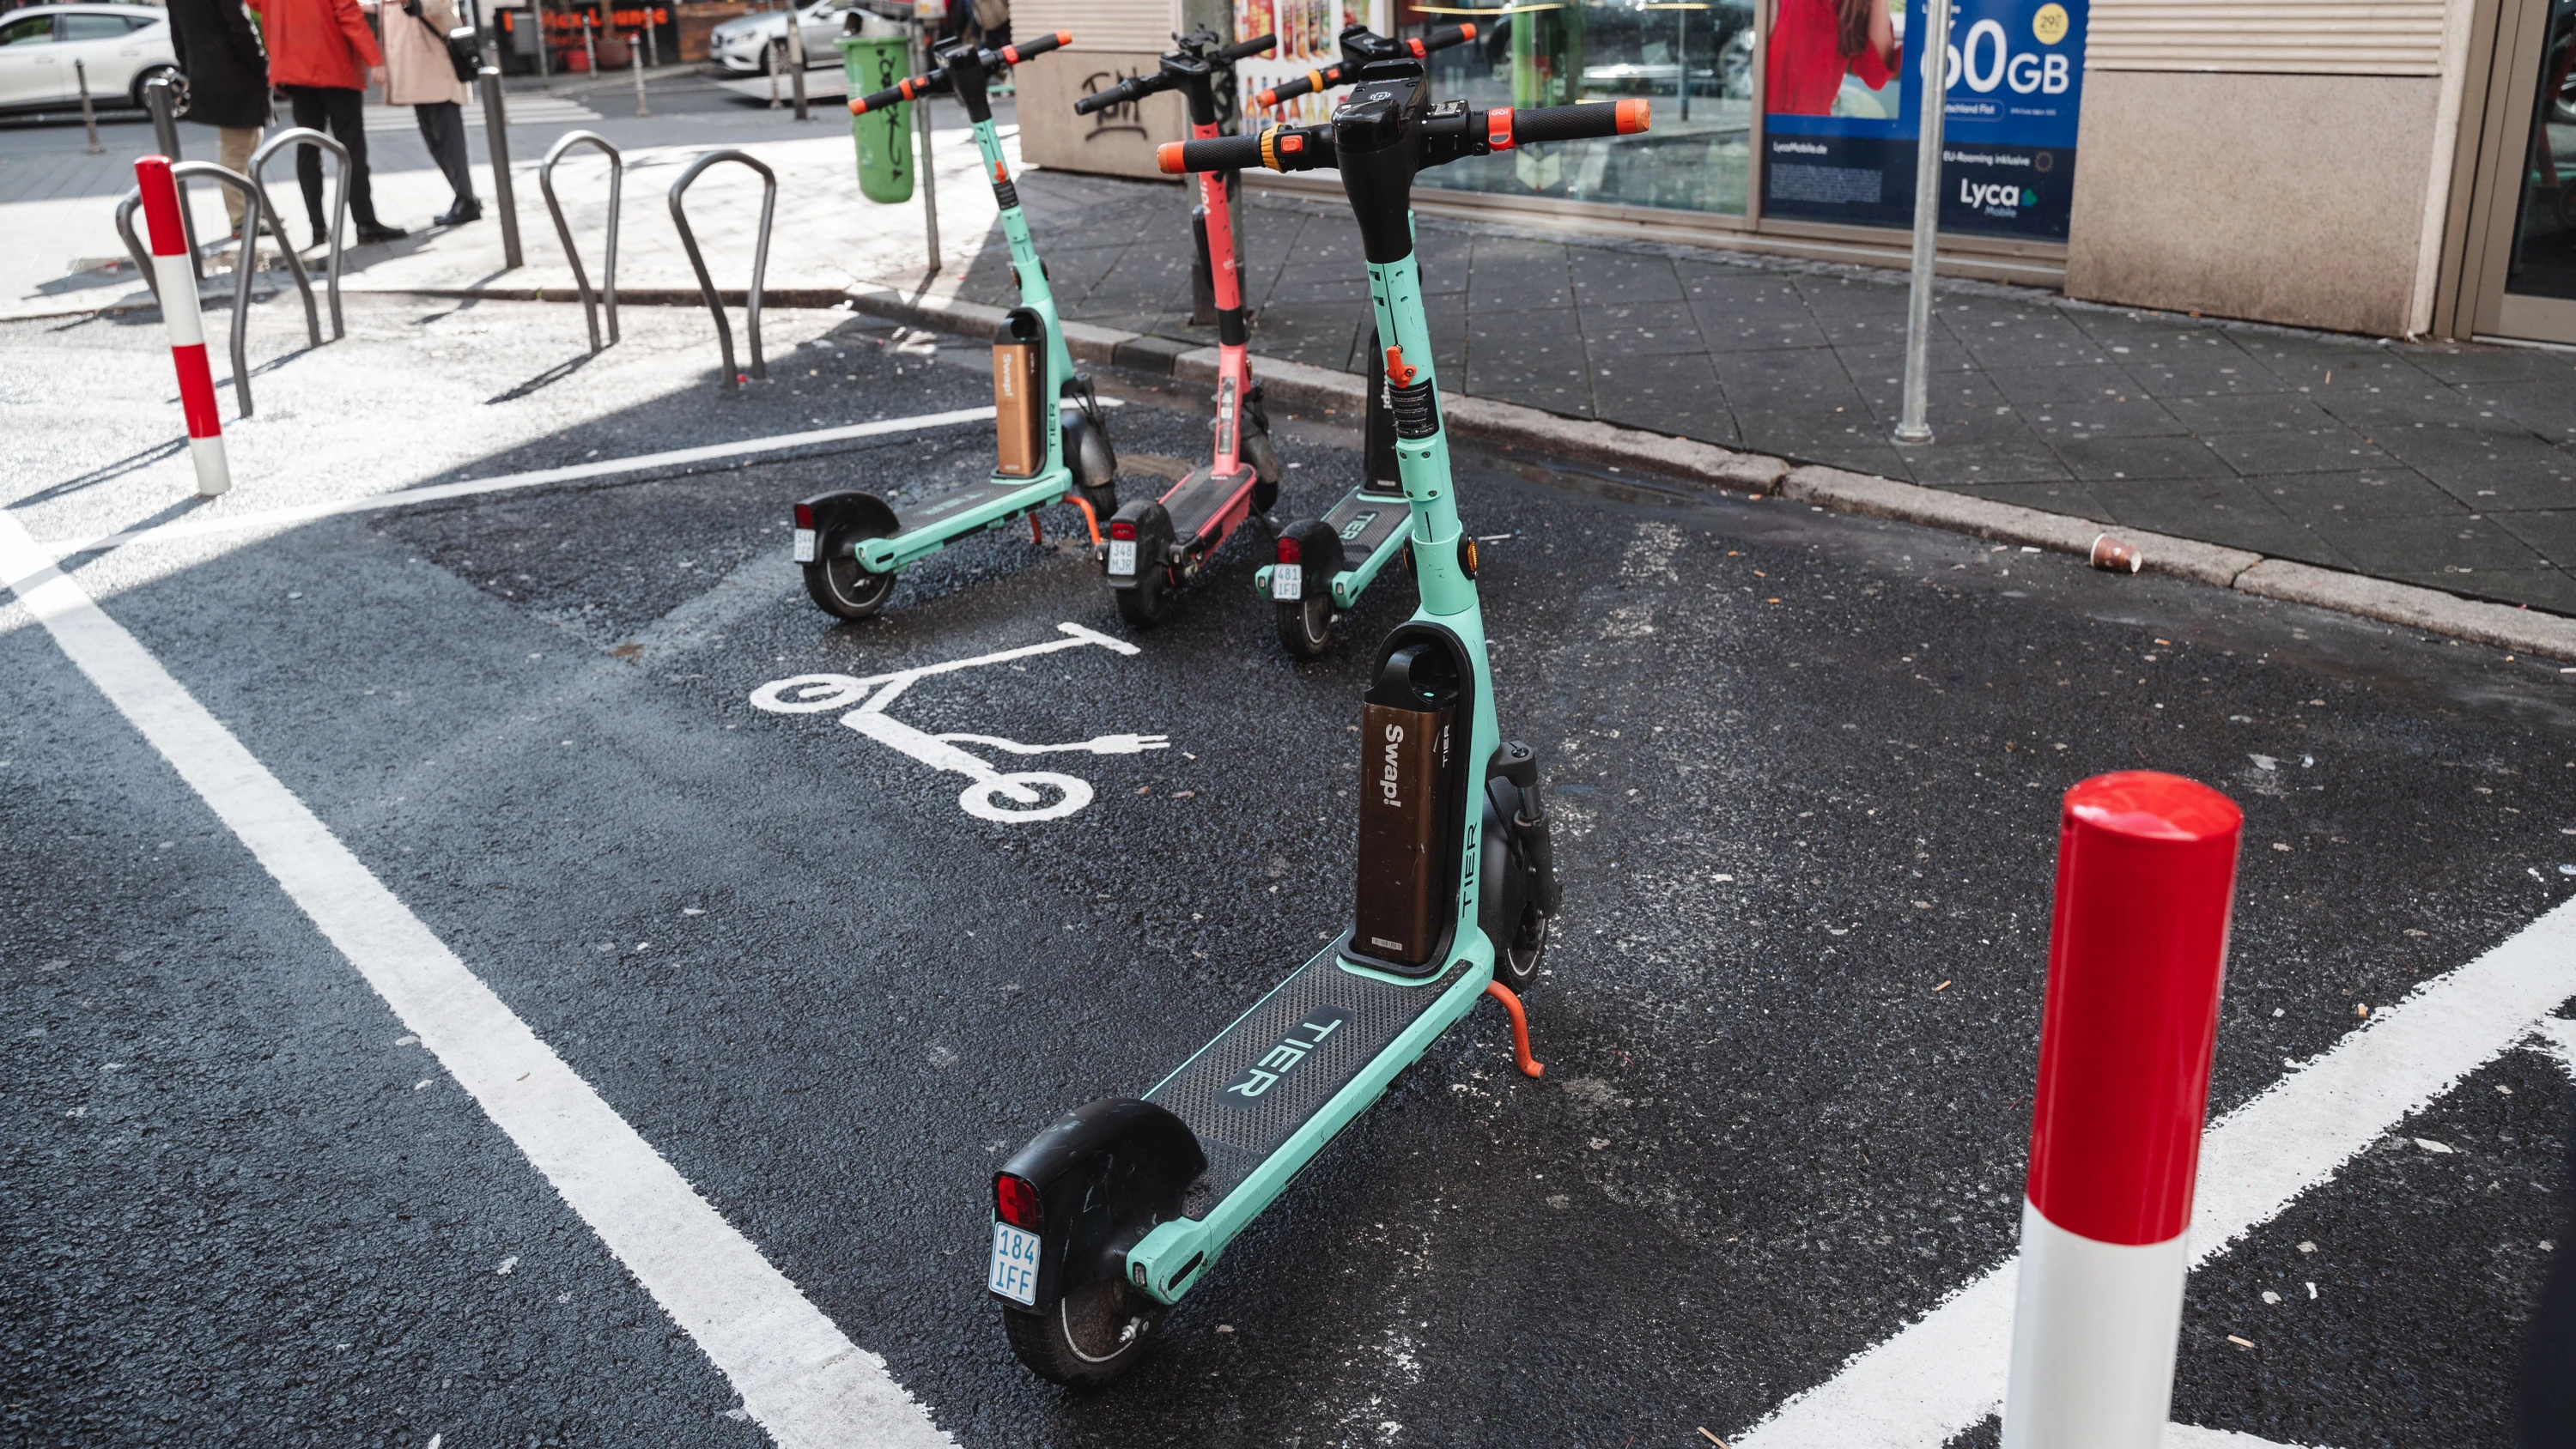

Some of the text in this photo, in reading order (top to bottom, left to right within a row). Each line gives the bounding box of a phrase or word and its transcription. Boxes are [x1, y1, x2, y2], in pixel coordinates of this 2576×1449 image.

[1942, 150, 2031, 167] EU-Roaming inklusive
[1960, 178, 2020, 209] Lyca
[1984, 204, 2017, 219] Mobile
[1002, 353, 1014, 397] Swap!
[1048, 403, 1057, 452] TIER
[1339, 512, 1377, 540] TIER
[1111, 559, 1133, 572] MJR
[1113, 544, 1133, 557] 348
[1278, 567, 1298, 580] 481
[1442, 724, 1450, 768] TIER
[1379, 724, 1404, 808] Swap!
[1461, 822, 1478, 919] TIER
[1227, 1019, 1343, 1097] TIER
[999, 1229, 1035, 1265] 184
[996, 1261, 1032, 1295] IFF
